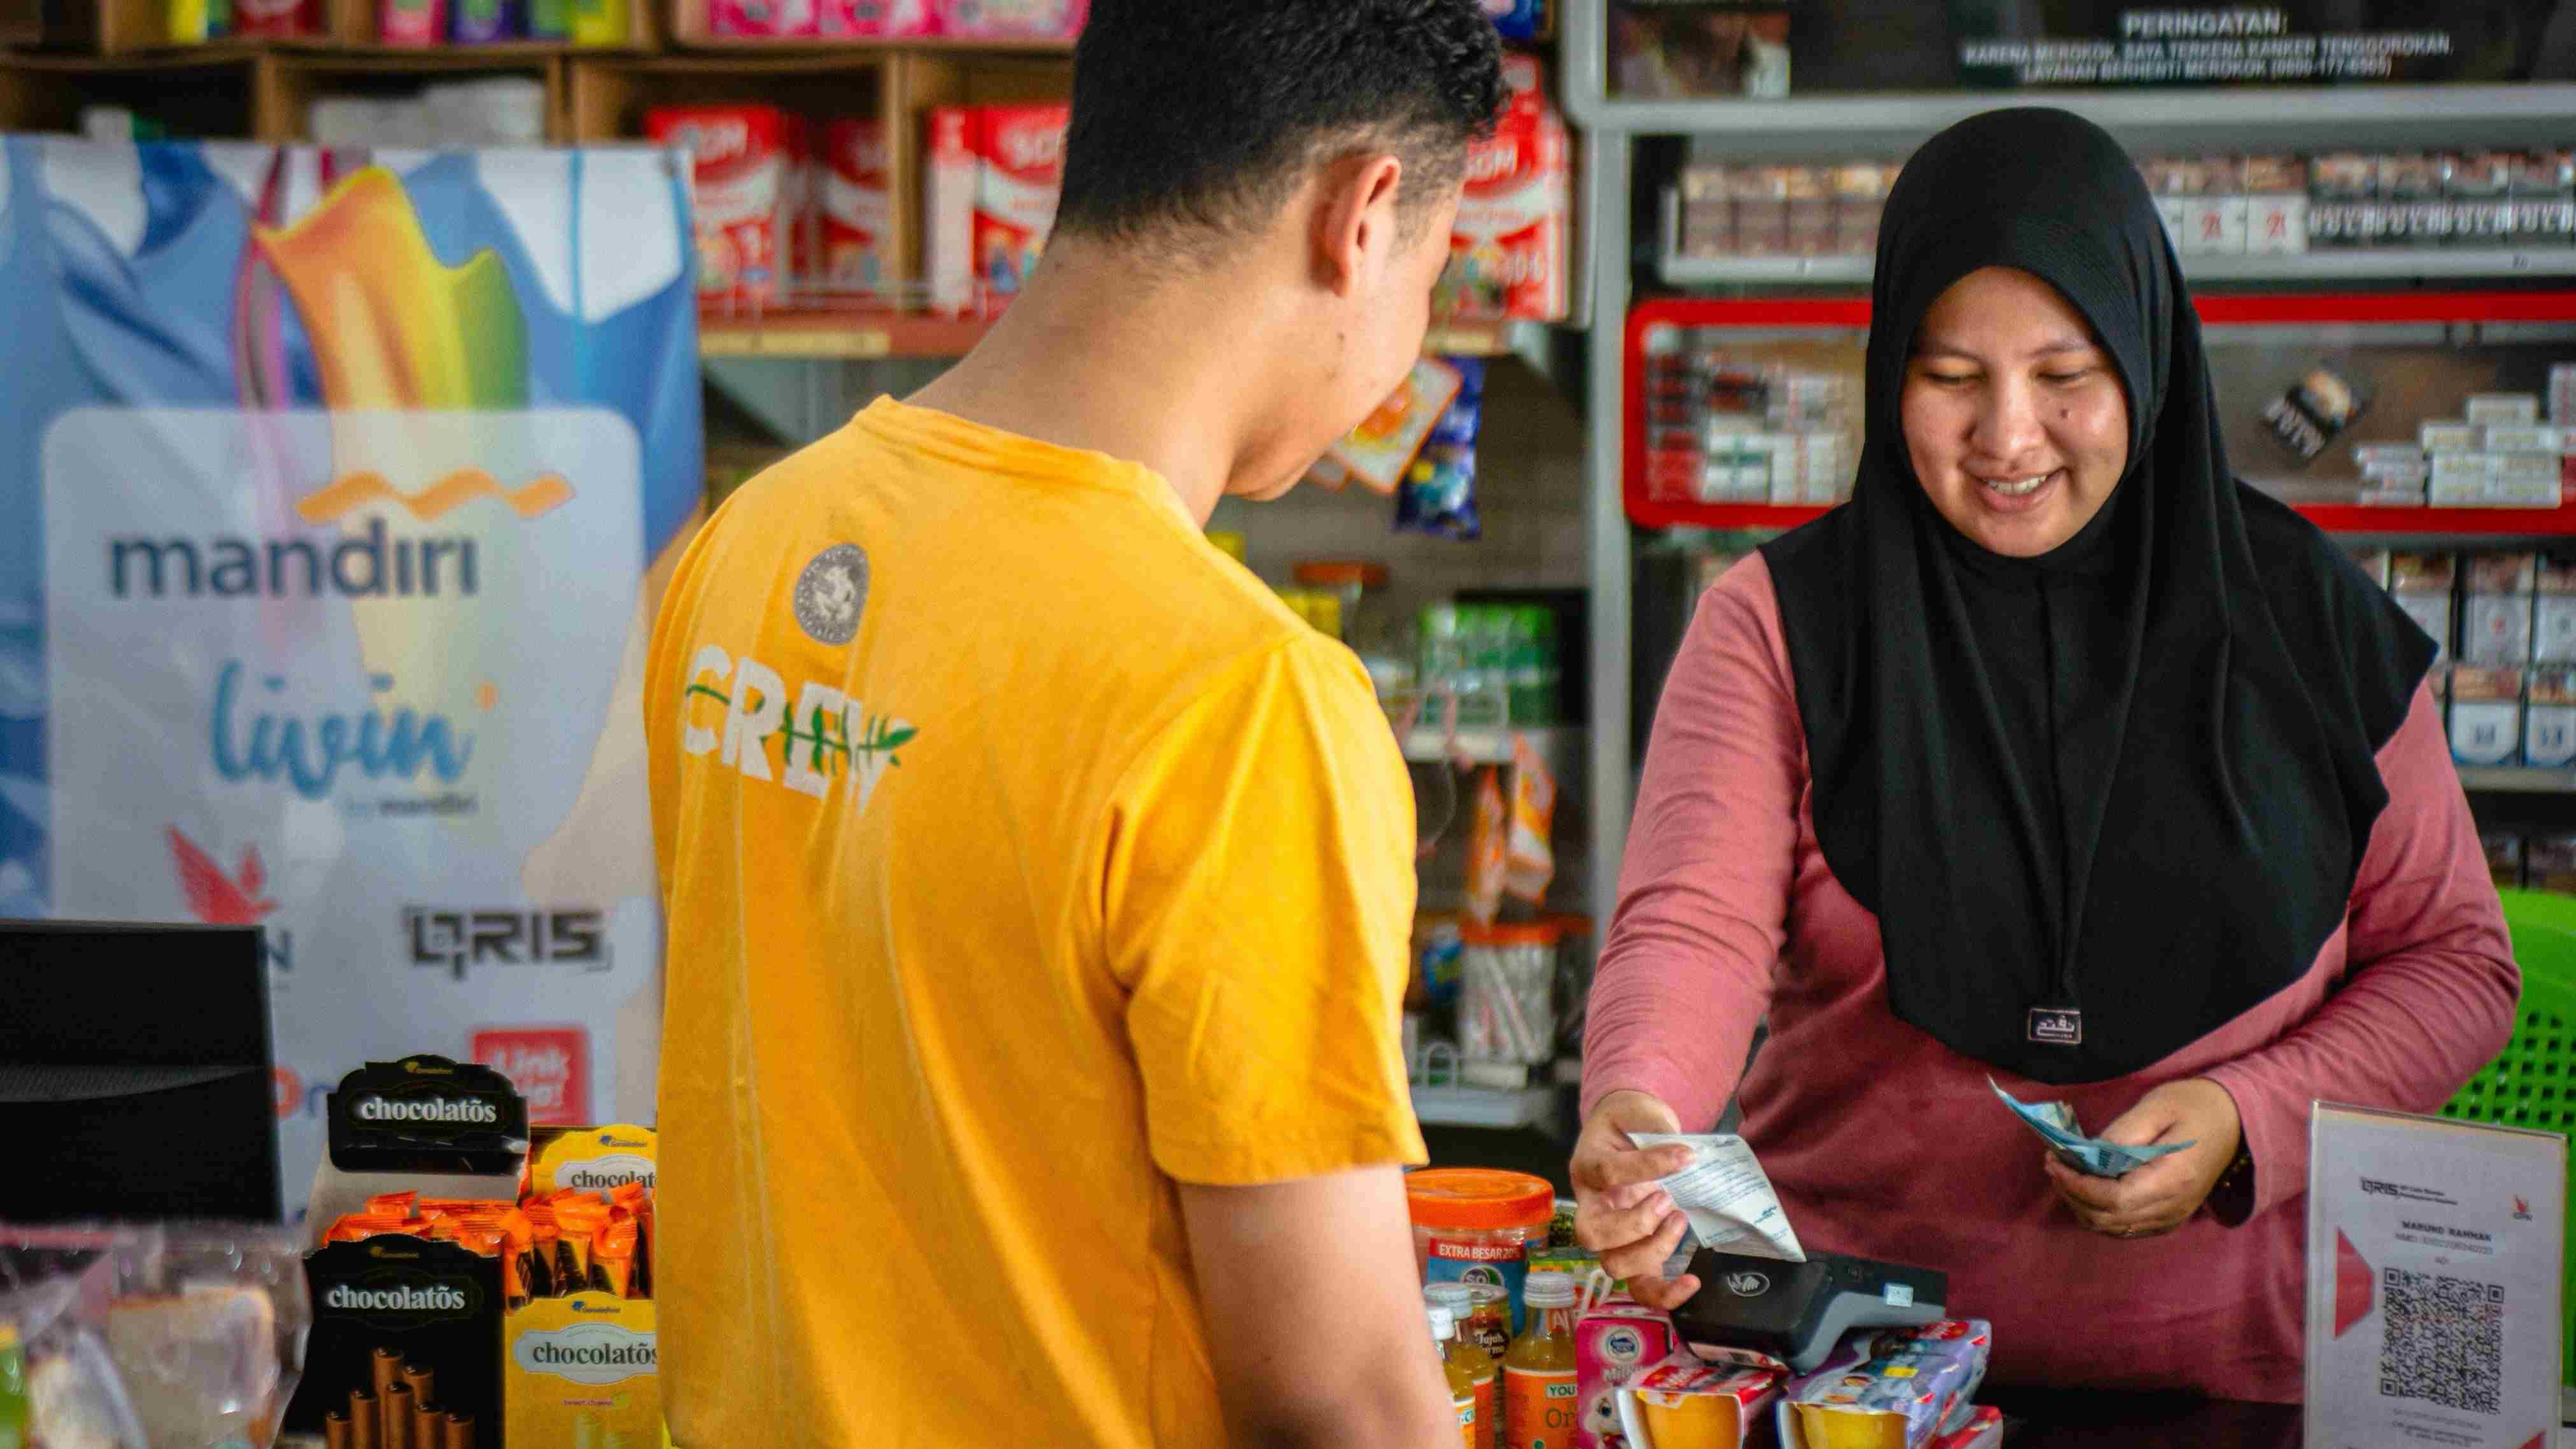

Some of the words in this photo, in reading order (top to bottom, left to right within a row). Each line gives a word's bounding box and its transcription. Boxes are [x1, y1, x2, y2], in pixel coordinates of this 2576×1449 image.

[570, 1170, 658, 1189] chocolat
[1438, 1243, 1470, 1259] EXTRA
[1471, 1246, 1502, 1260] BESAR
